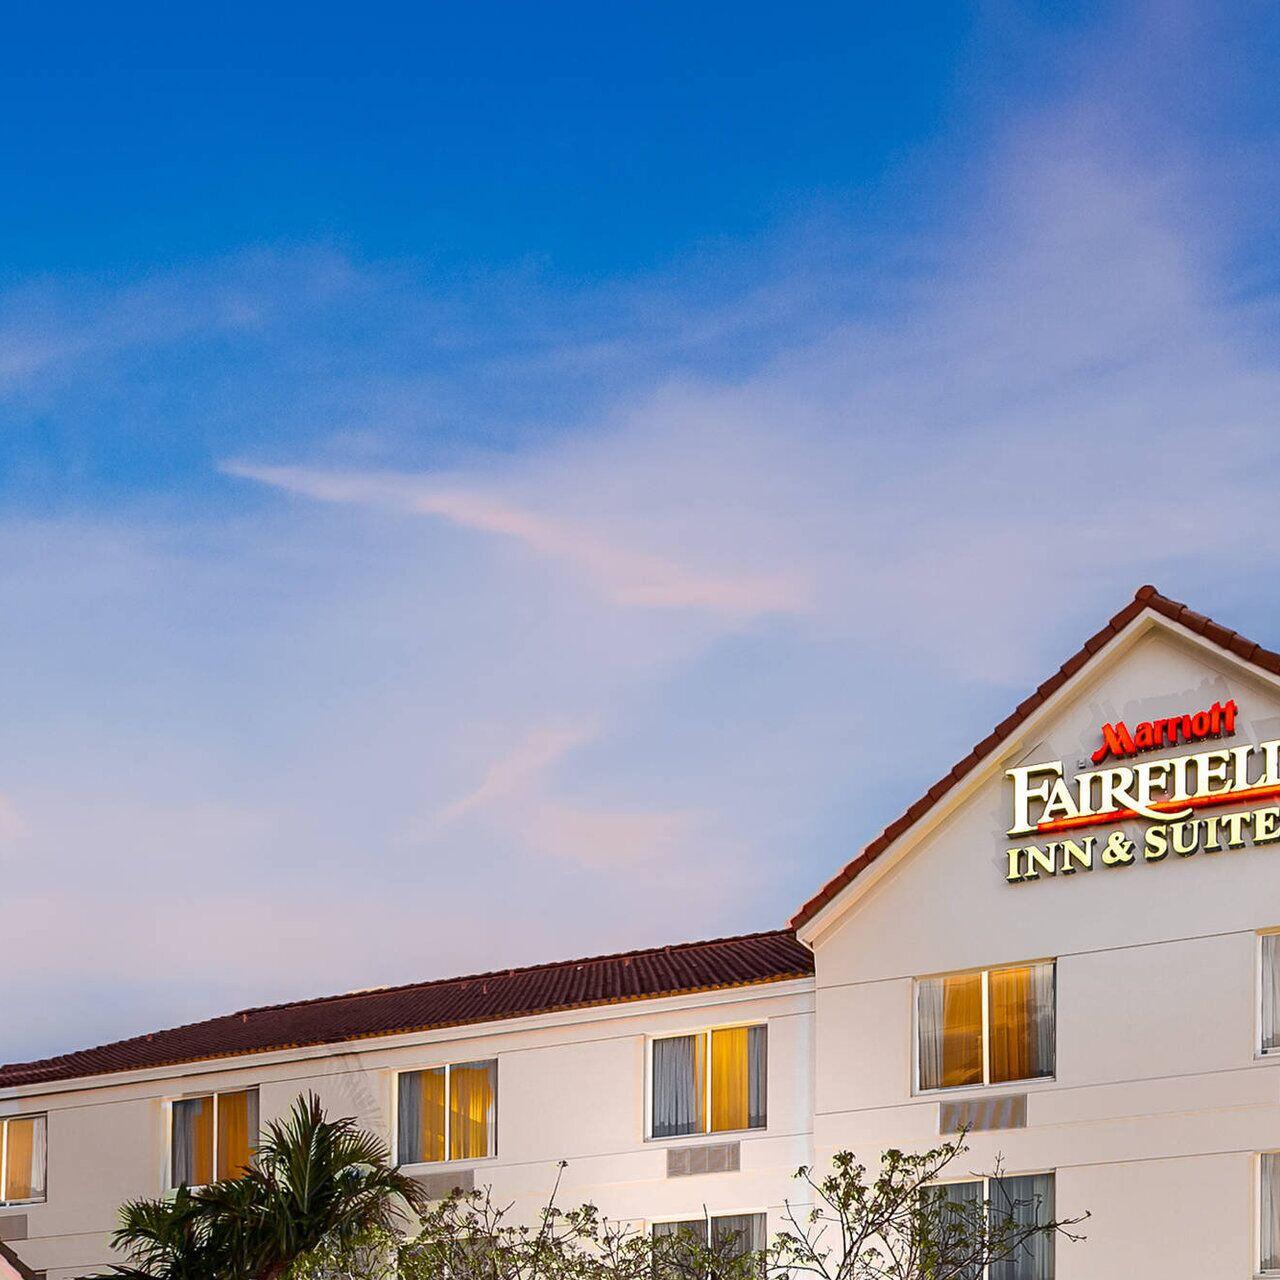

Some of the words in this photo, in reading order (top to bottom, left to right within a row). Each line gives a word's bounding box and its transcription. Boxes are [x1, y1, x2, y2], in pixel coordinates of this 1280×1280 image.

[1091, 699, 1237, 765] Marriott
[1006, 836, 1095, 883] INN
[1101, 830, 1135, 867] &
